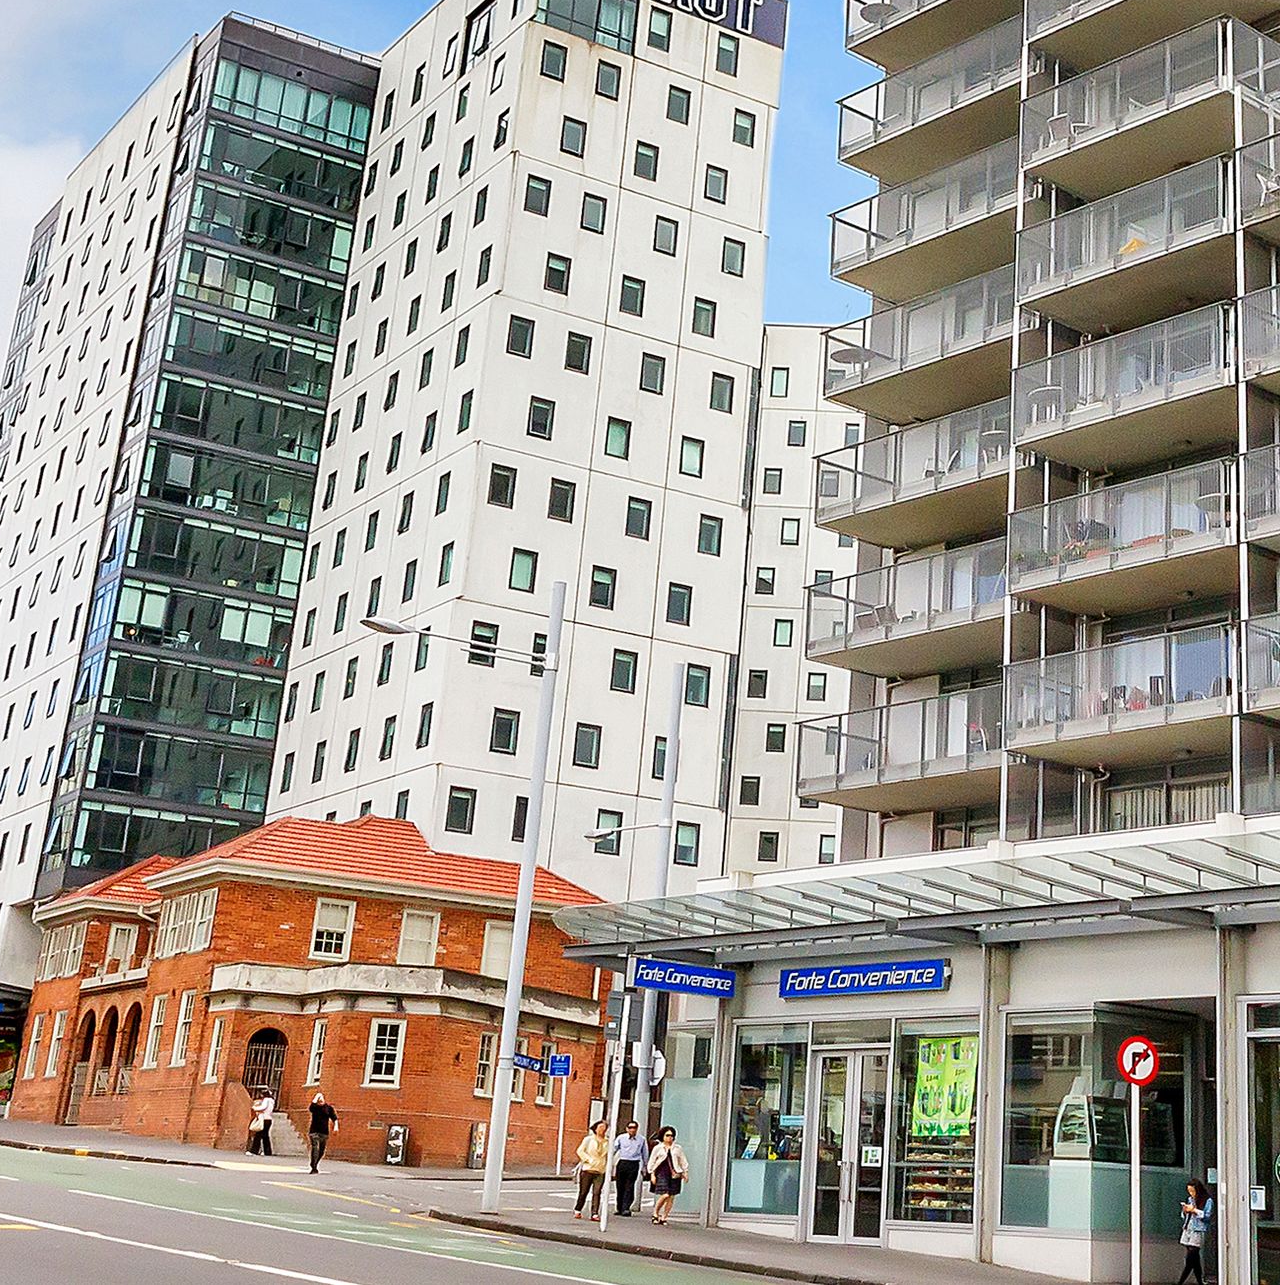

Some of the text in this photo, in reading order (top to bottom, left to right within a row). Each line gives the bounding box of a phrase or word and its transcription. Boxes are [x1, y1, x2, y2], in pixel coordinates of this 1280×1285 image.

[637, 964, 732, 991] Forte Convenience
[786, 965, 936, 991] Forte Convenience
